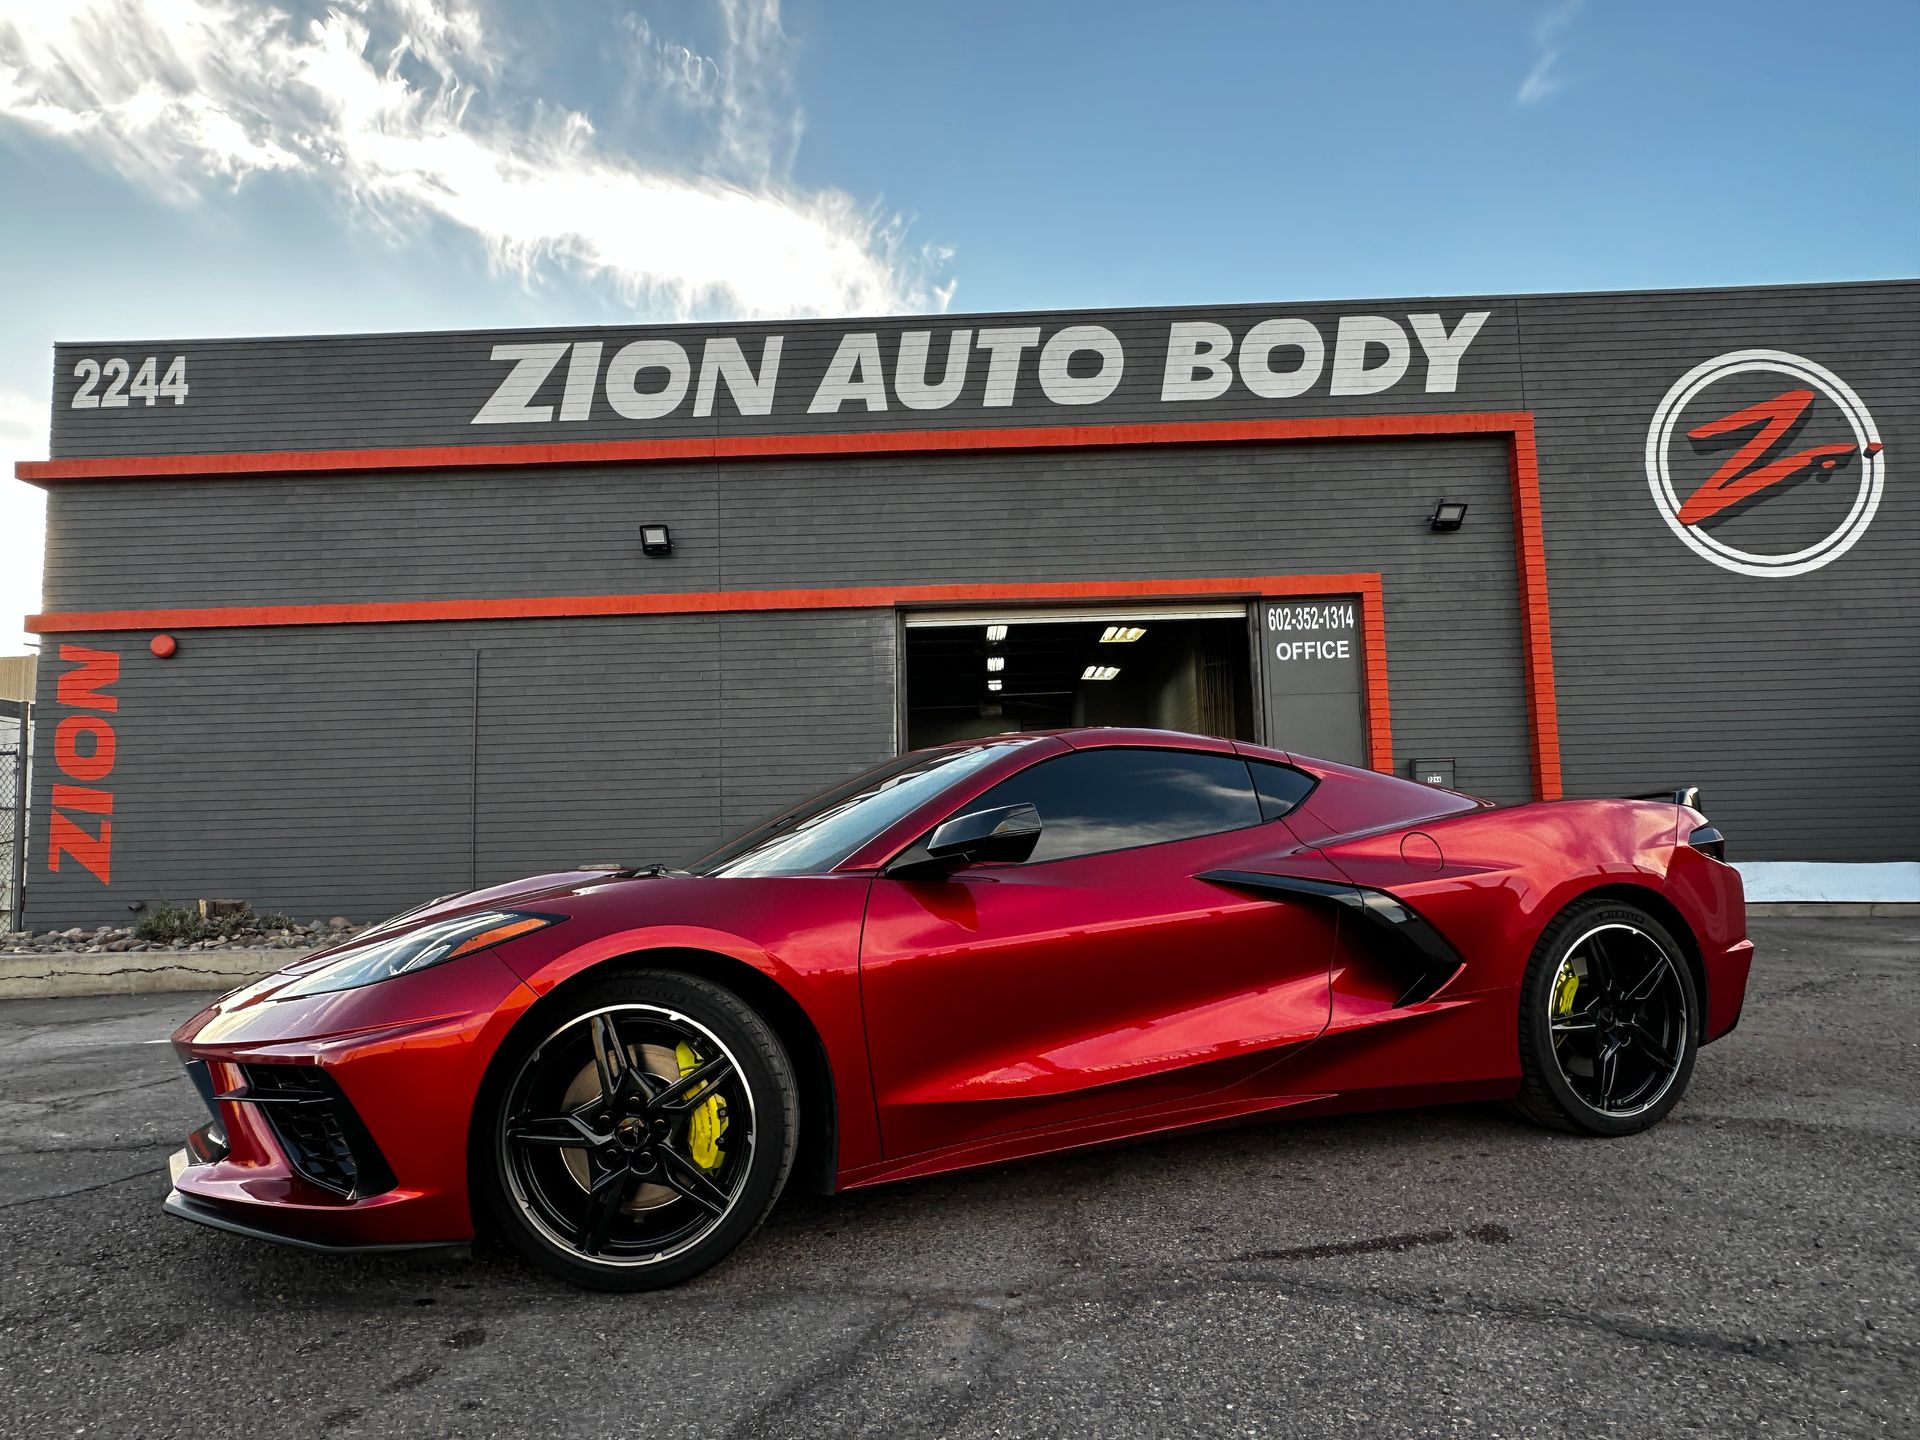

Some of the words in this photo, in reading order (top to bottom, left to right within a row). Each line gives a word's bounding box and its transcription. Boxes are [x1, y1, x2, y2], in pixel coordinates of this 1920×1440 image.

[71, 355, 189, 409] 2244
[470, 335, 784, 425] ZION
[806, 324, 1125, 414] AUTO
[1160, 311, 1491, 402] BODY
[1267, 604, 1355, 632] 602-352-1314
[1275, 640, 1351, 661] OFFICE
[48, 643, 120, 886] ZION
